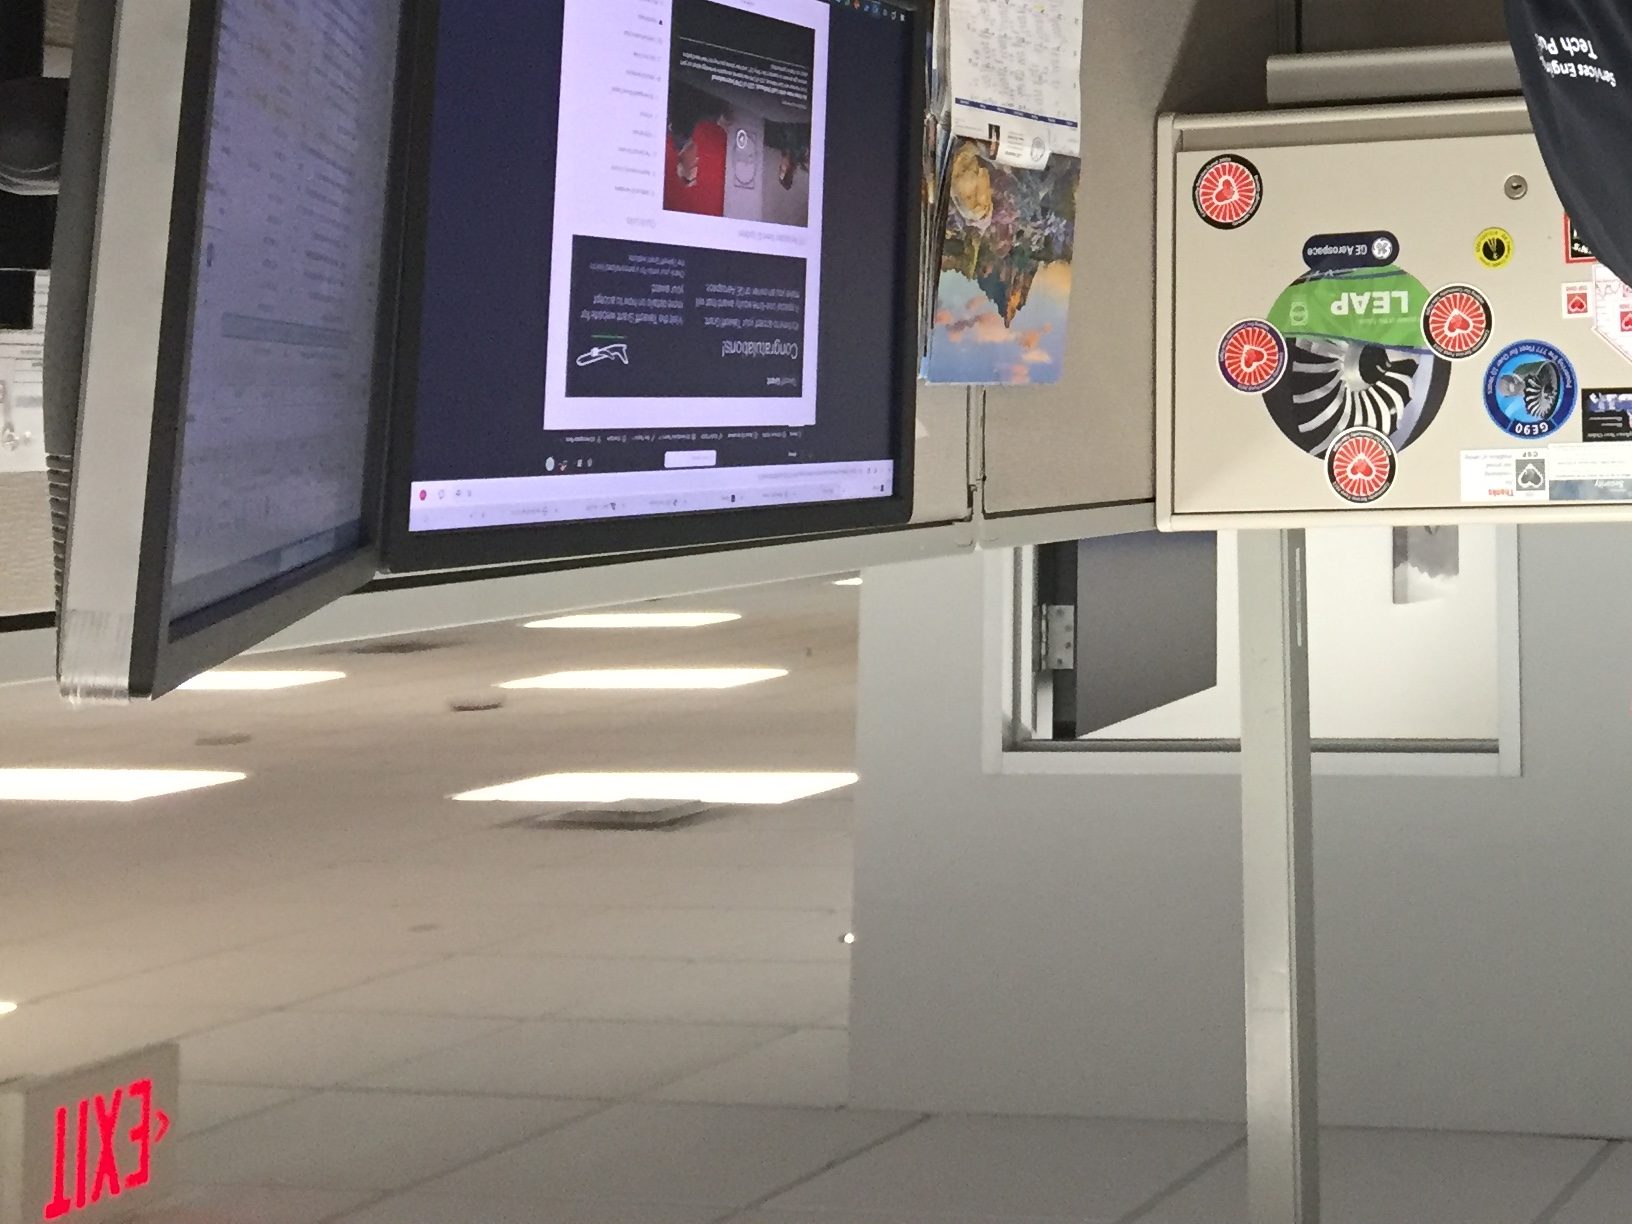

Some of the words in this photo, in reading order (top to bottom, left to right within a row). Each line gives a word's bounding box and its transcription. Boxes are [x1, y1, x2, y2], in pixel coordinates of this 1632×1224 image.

[1560, 36, 1598, 60] Tech
[1577, 63, 1616, 88] Services
[1307, 244, 1354, 258] Aerospace
[1356, 244, 1368, 256] GE
[1330, 290, 1408, 316] LEAP
[722, 338, 798, 360] Congratulations!
[1557, 358, 1572, 388] Powering
[1514, 422, 1548, 435] GE90
[1488, 488, 1514, 497] Thanks
[43, 1078, 152, 1221] EXIT
